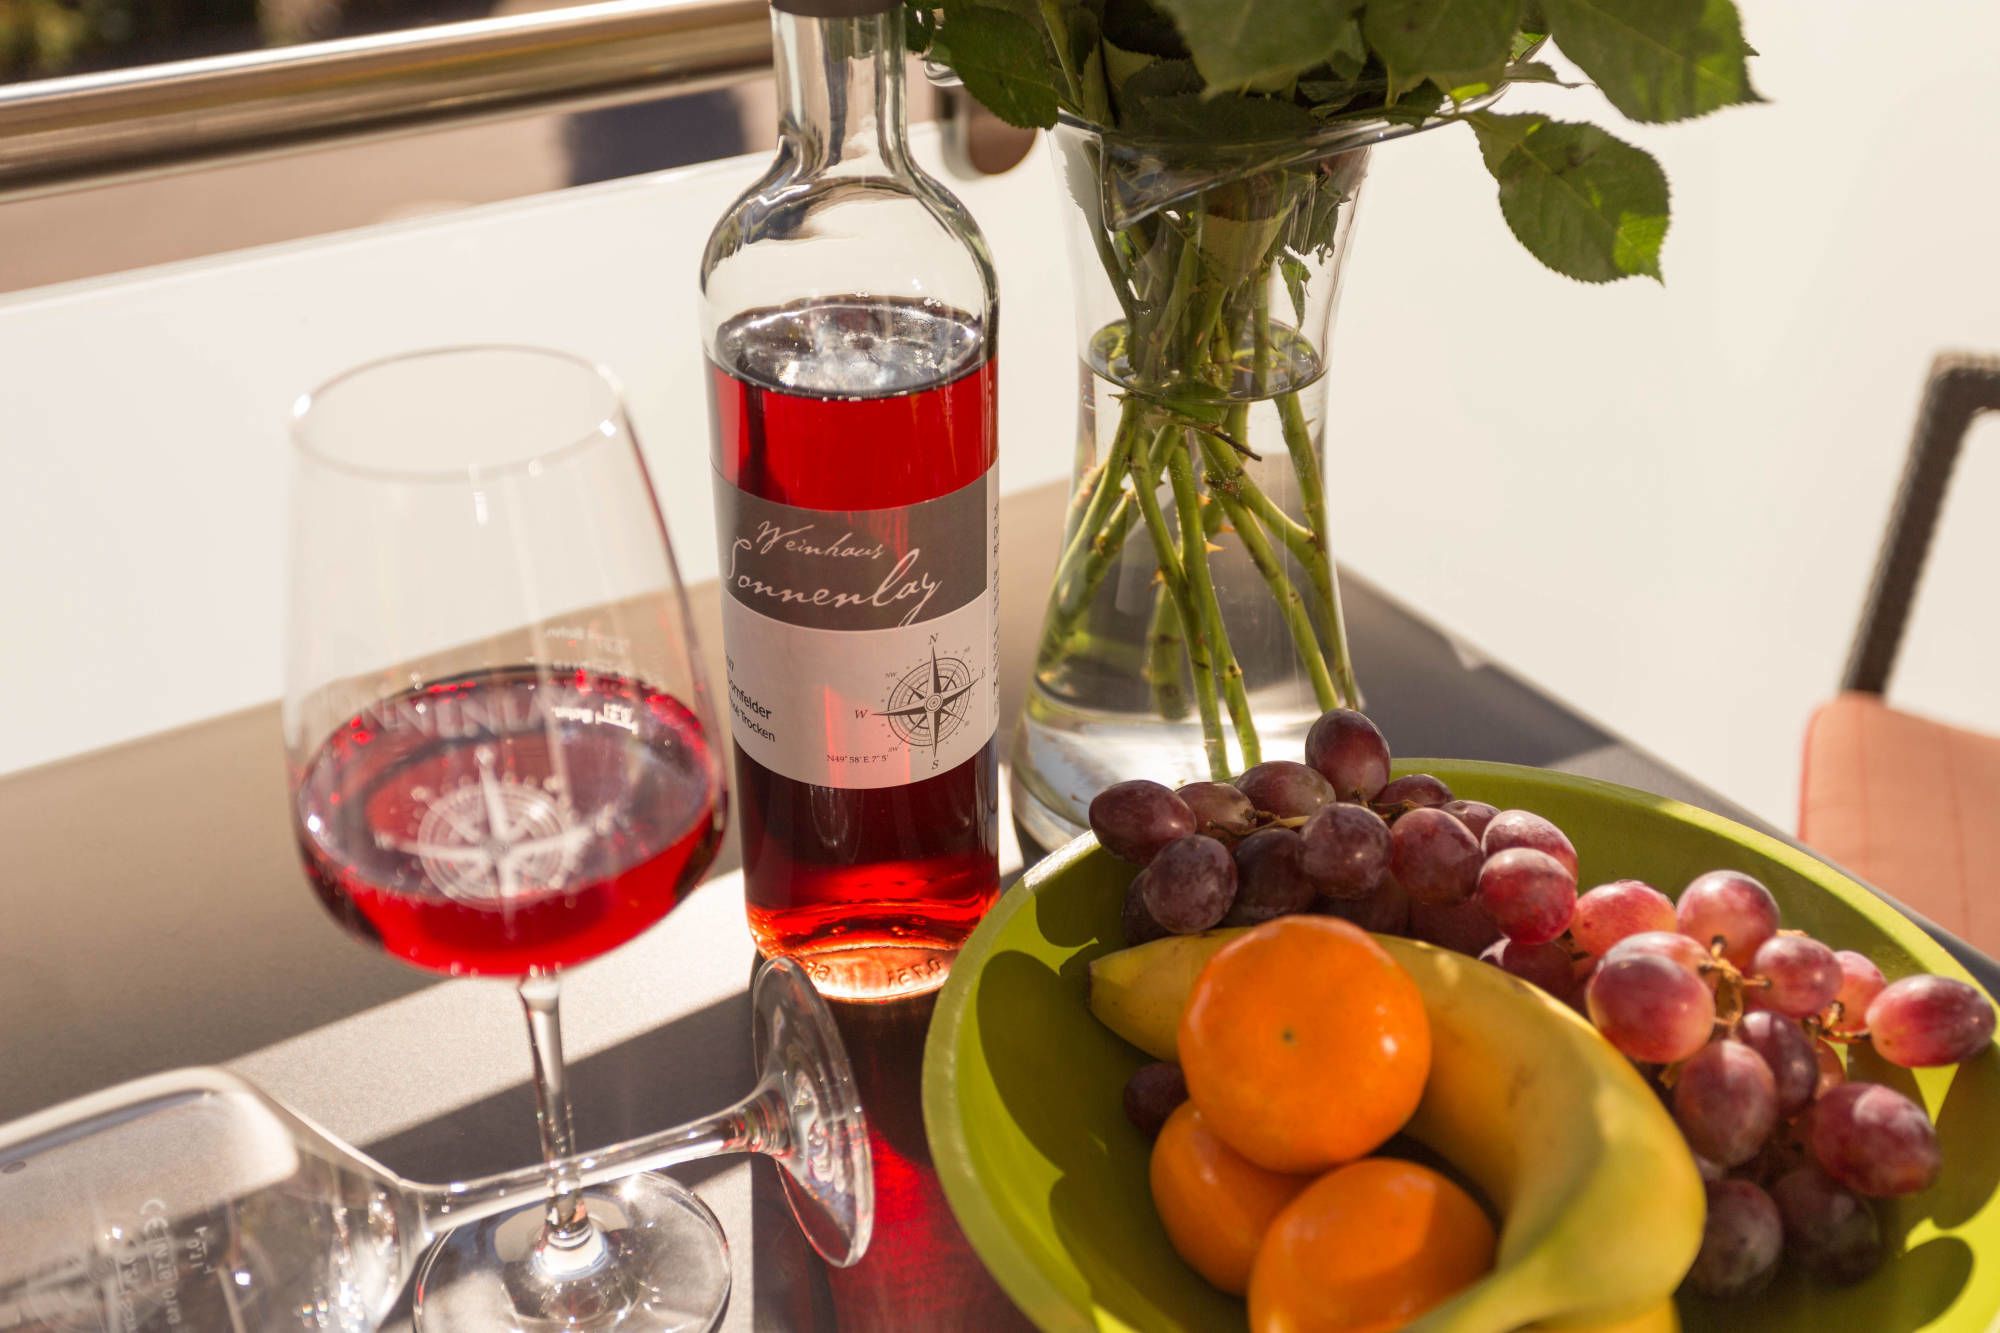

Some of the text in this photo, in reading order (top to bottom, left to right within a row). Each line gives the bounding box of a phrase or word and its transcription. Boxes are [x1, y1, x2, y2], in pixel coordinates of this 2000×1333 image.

[755, 520, 885, 560] Weinhaus
[727, 536, 943, 628] Sonnenlay
[928, 632, 939, 645] N
[728, 679, 772, 720] ornfelder
[854, 708, 869, 719] W
[931, 759, 939, 770] S
